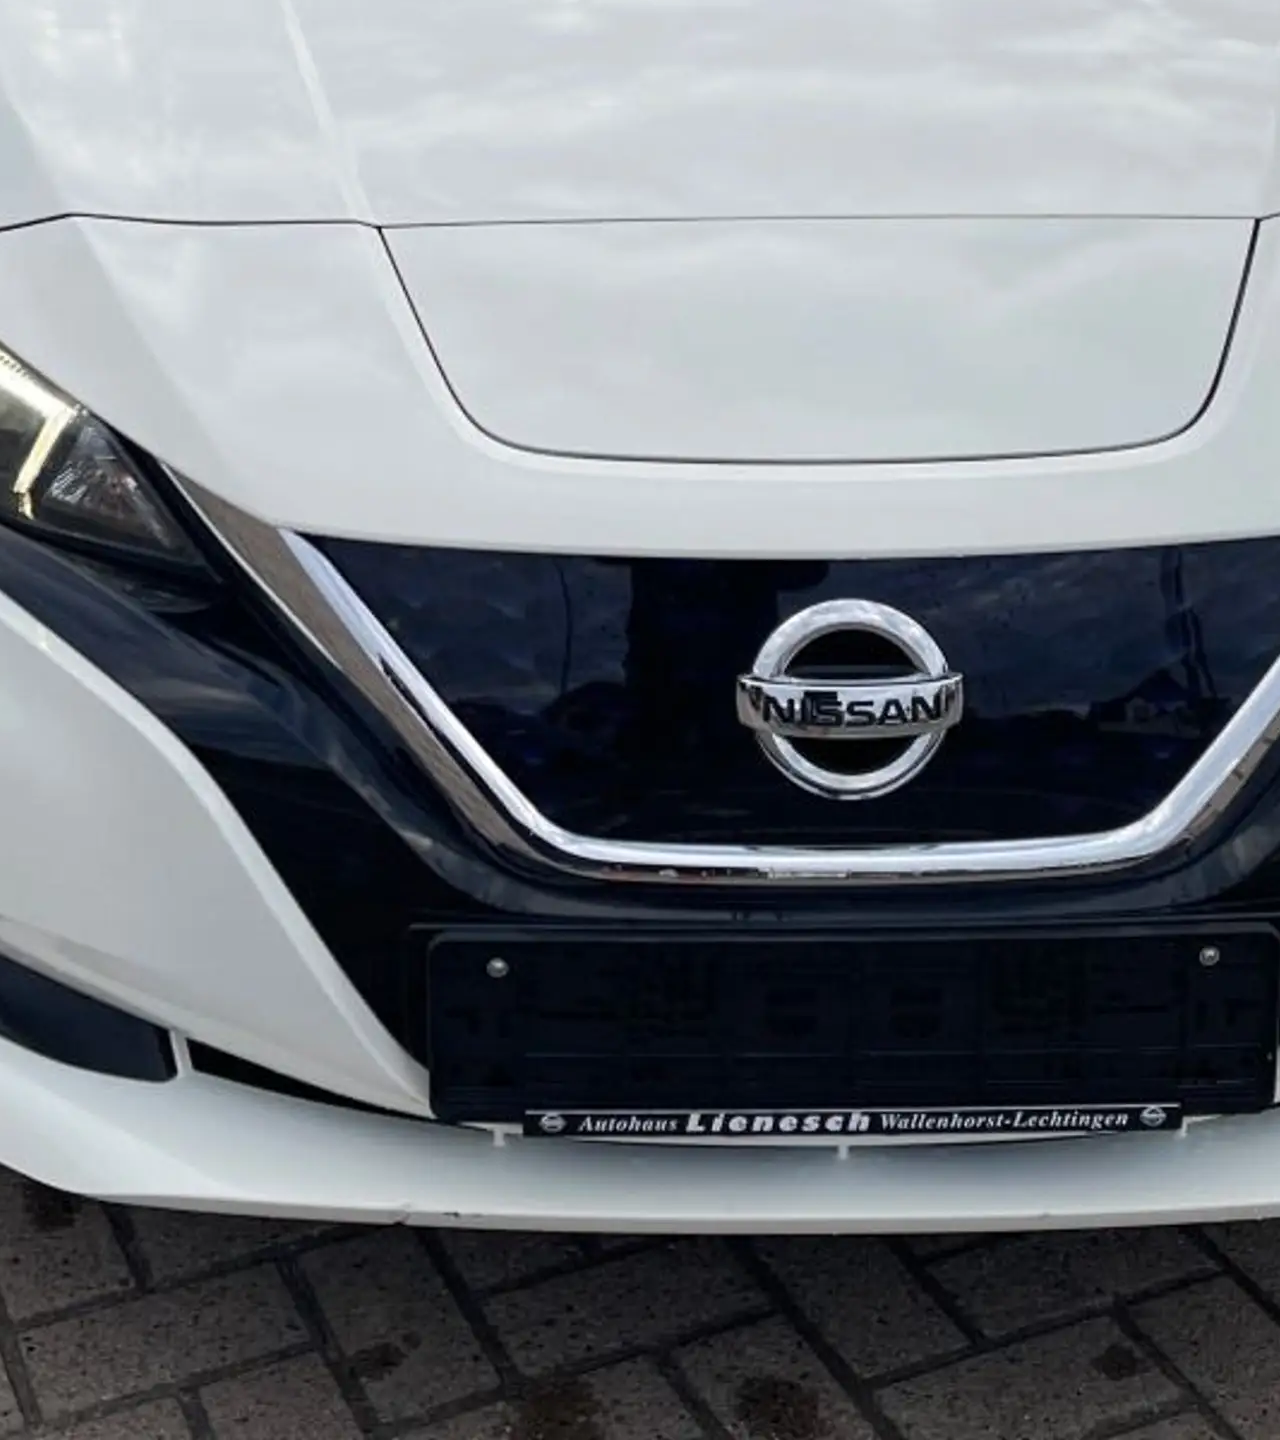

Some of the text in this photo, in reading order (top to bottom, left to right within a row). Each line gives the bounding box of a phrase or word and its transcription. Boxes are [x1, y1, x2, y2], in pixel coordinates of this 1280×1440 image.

[762, 692, 942, 727] NISSAN
[577, 1110, 1129, 1133] Autohaus Lienesch Wallenhorst-Lechtingen
